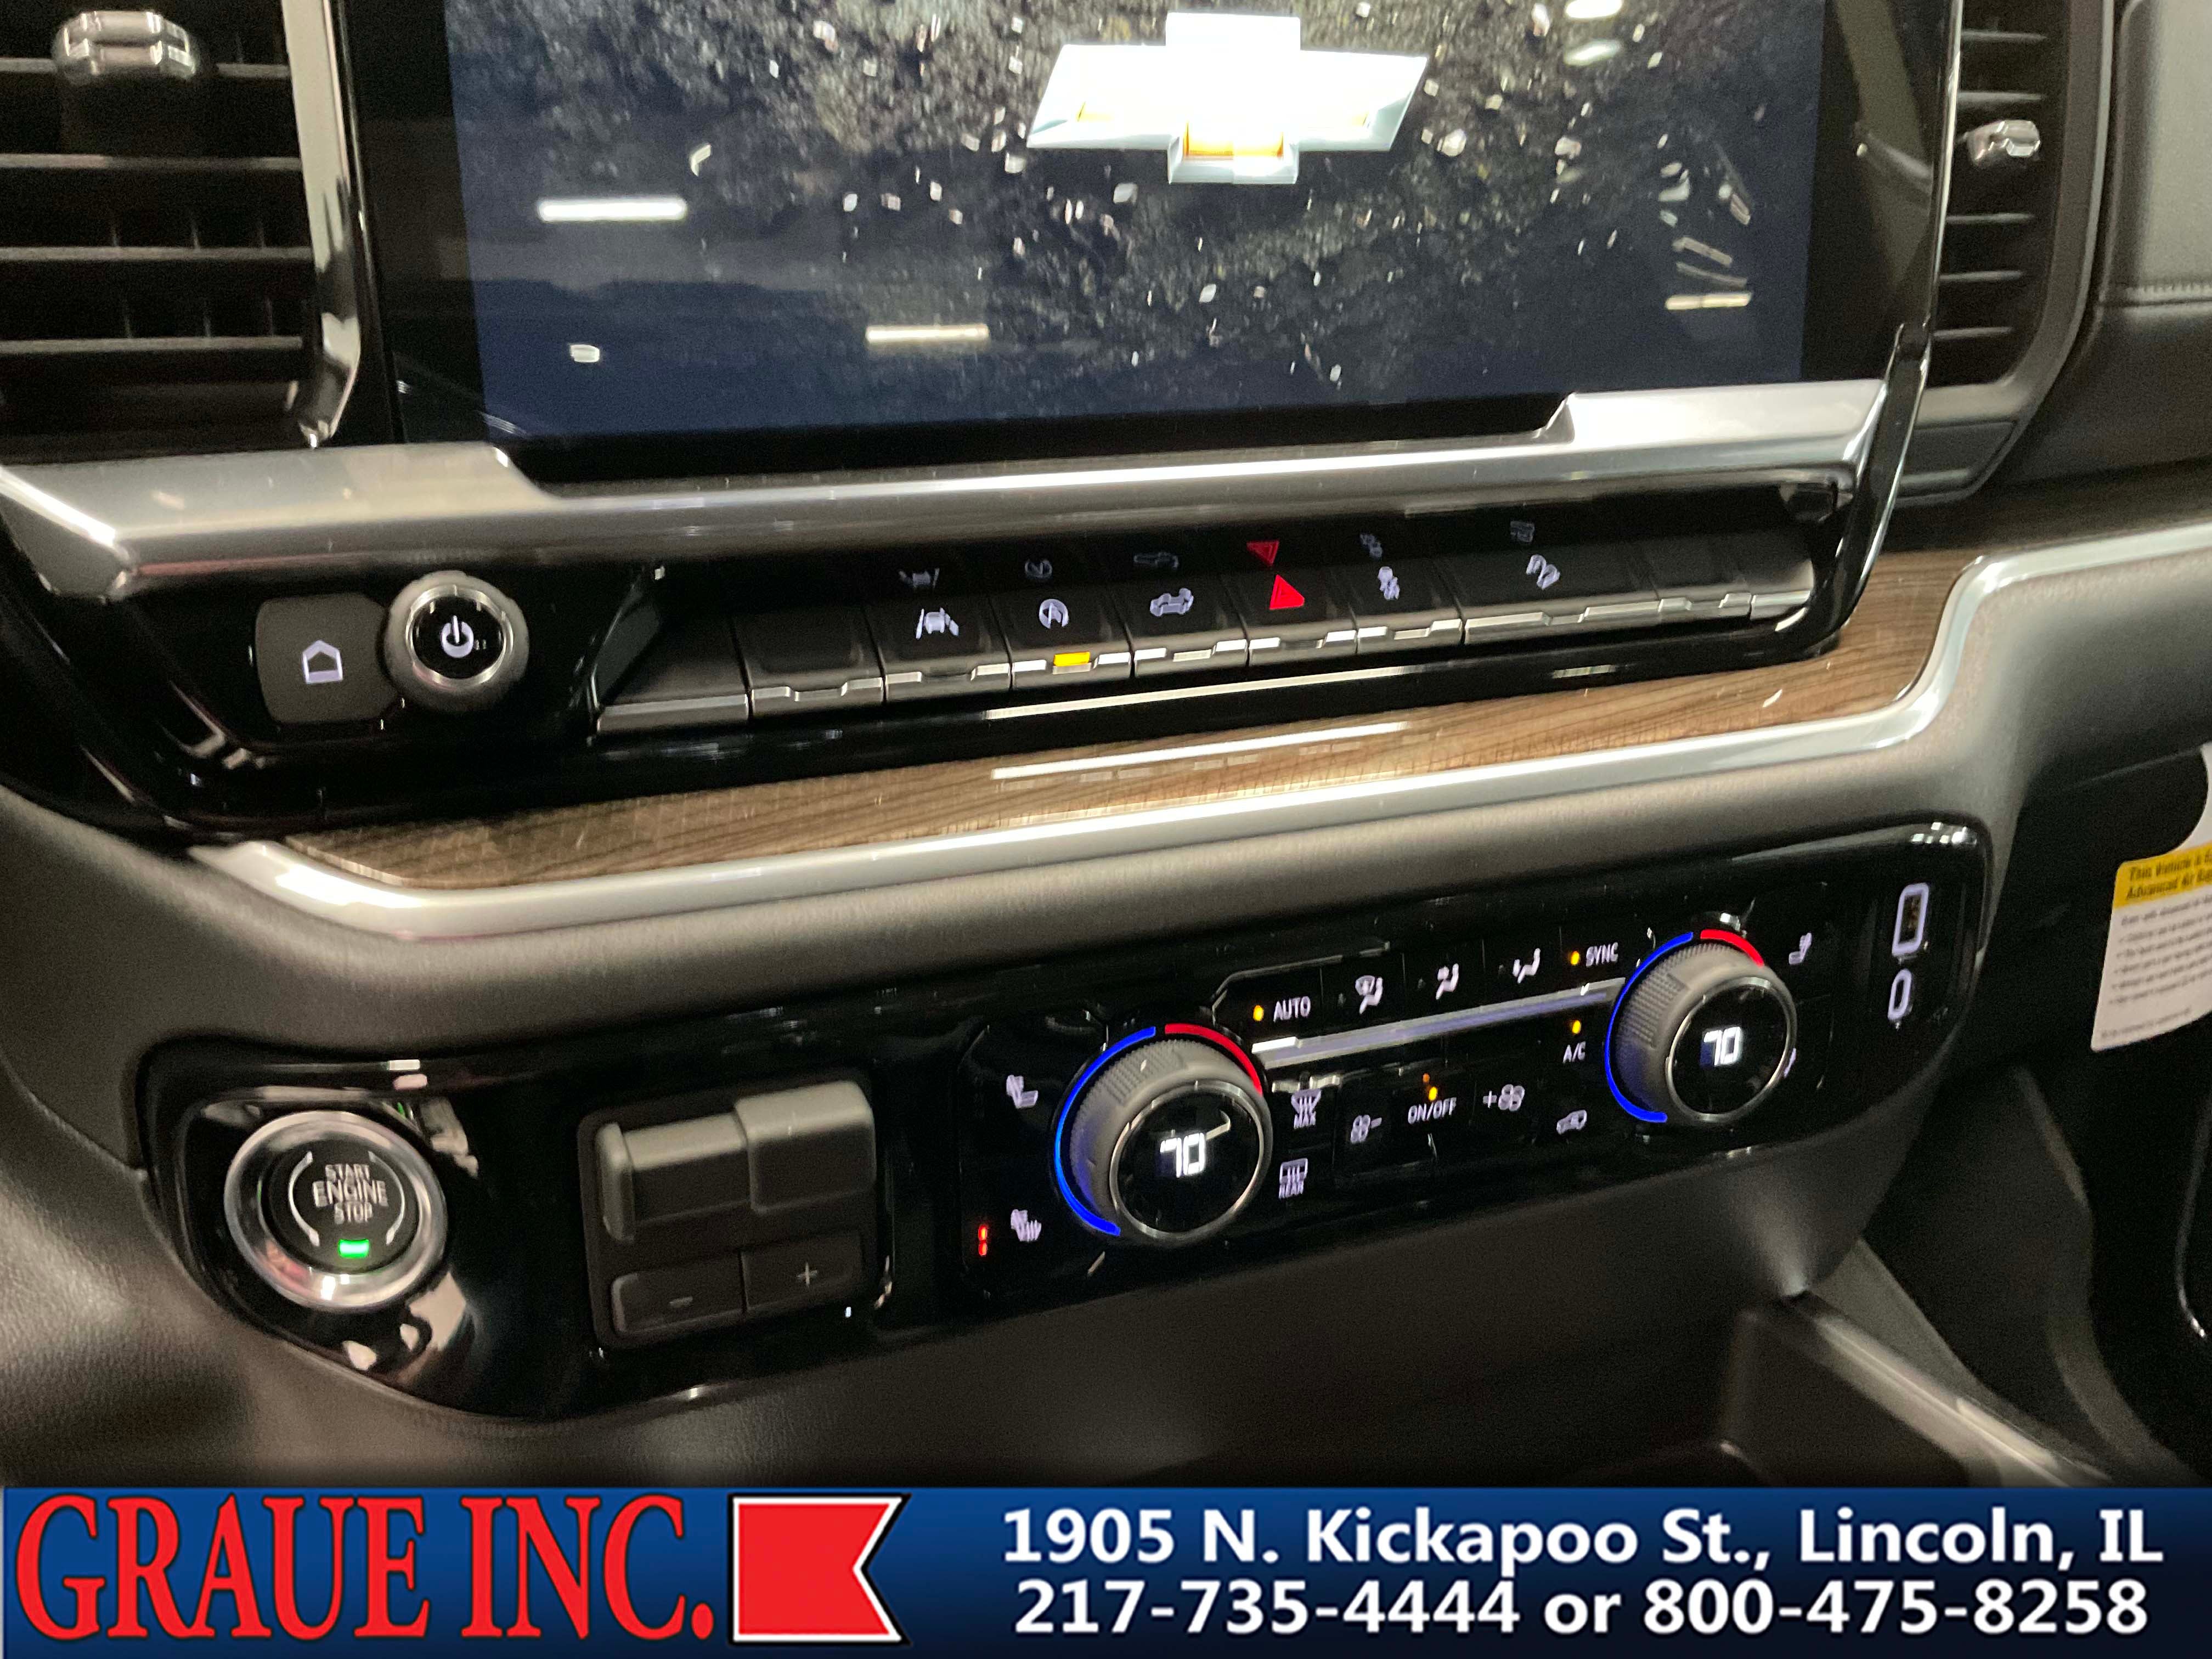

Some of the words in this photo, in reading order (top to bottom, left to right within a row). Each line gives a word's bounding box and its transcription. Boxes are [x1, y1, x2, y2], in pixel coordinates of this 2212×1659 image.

[1585, 942, 1619, 967] SYNC
[1273, 996, 1312, 1023] AUTO
[1562, 1041, 1586, 1063] A/C
[1702, 1026, 1743, 1067] 70
[1294, 1110, 1317, 1130] MAX
[1407, 1097, 1457, 1125] ON/OFF
[1159, 1132, 1206, 1178] 70
[324, 1163, 370, 1182] START
[312, 1180, 389, 1207] ENGINE
[334, 1201, 374, 1224] STOP
